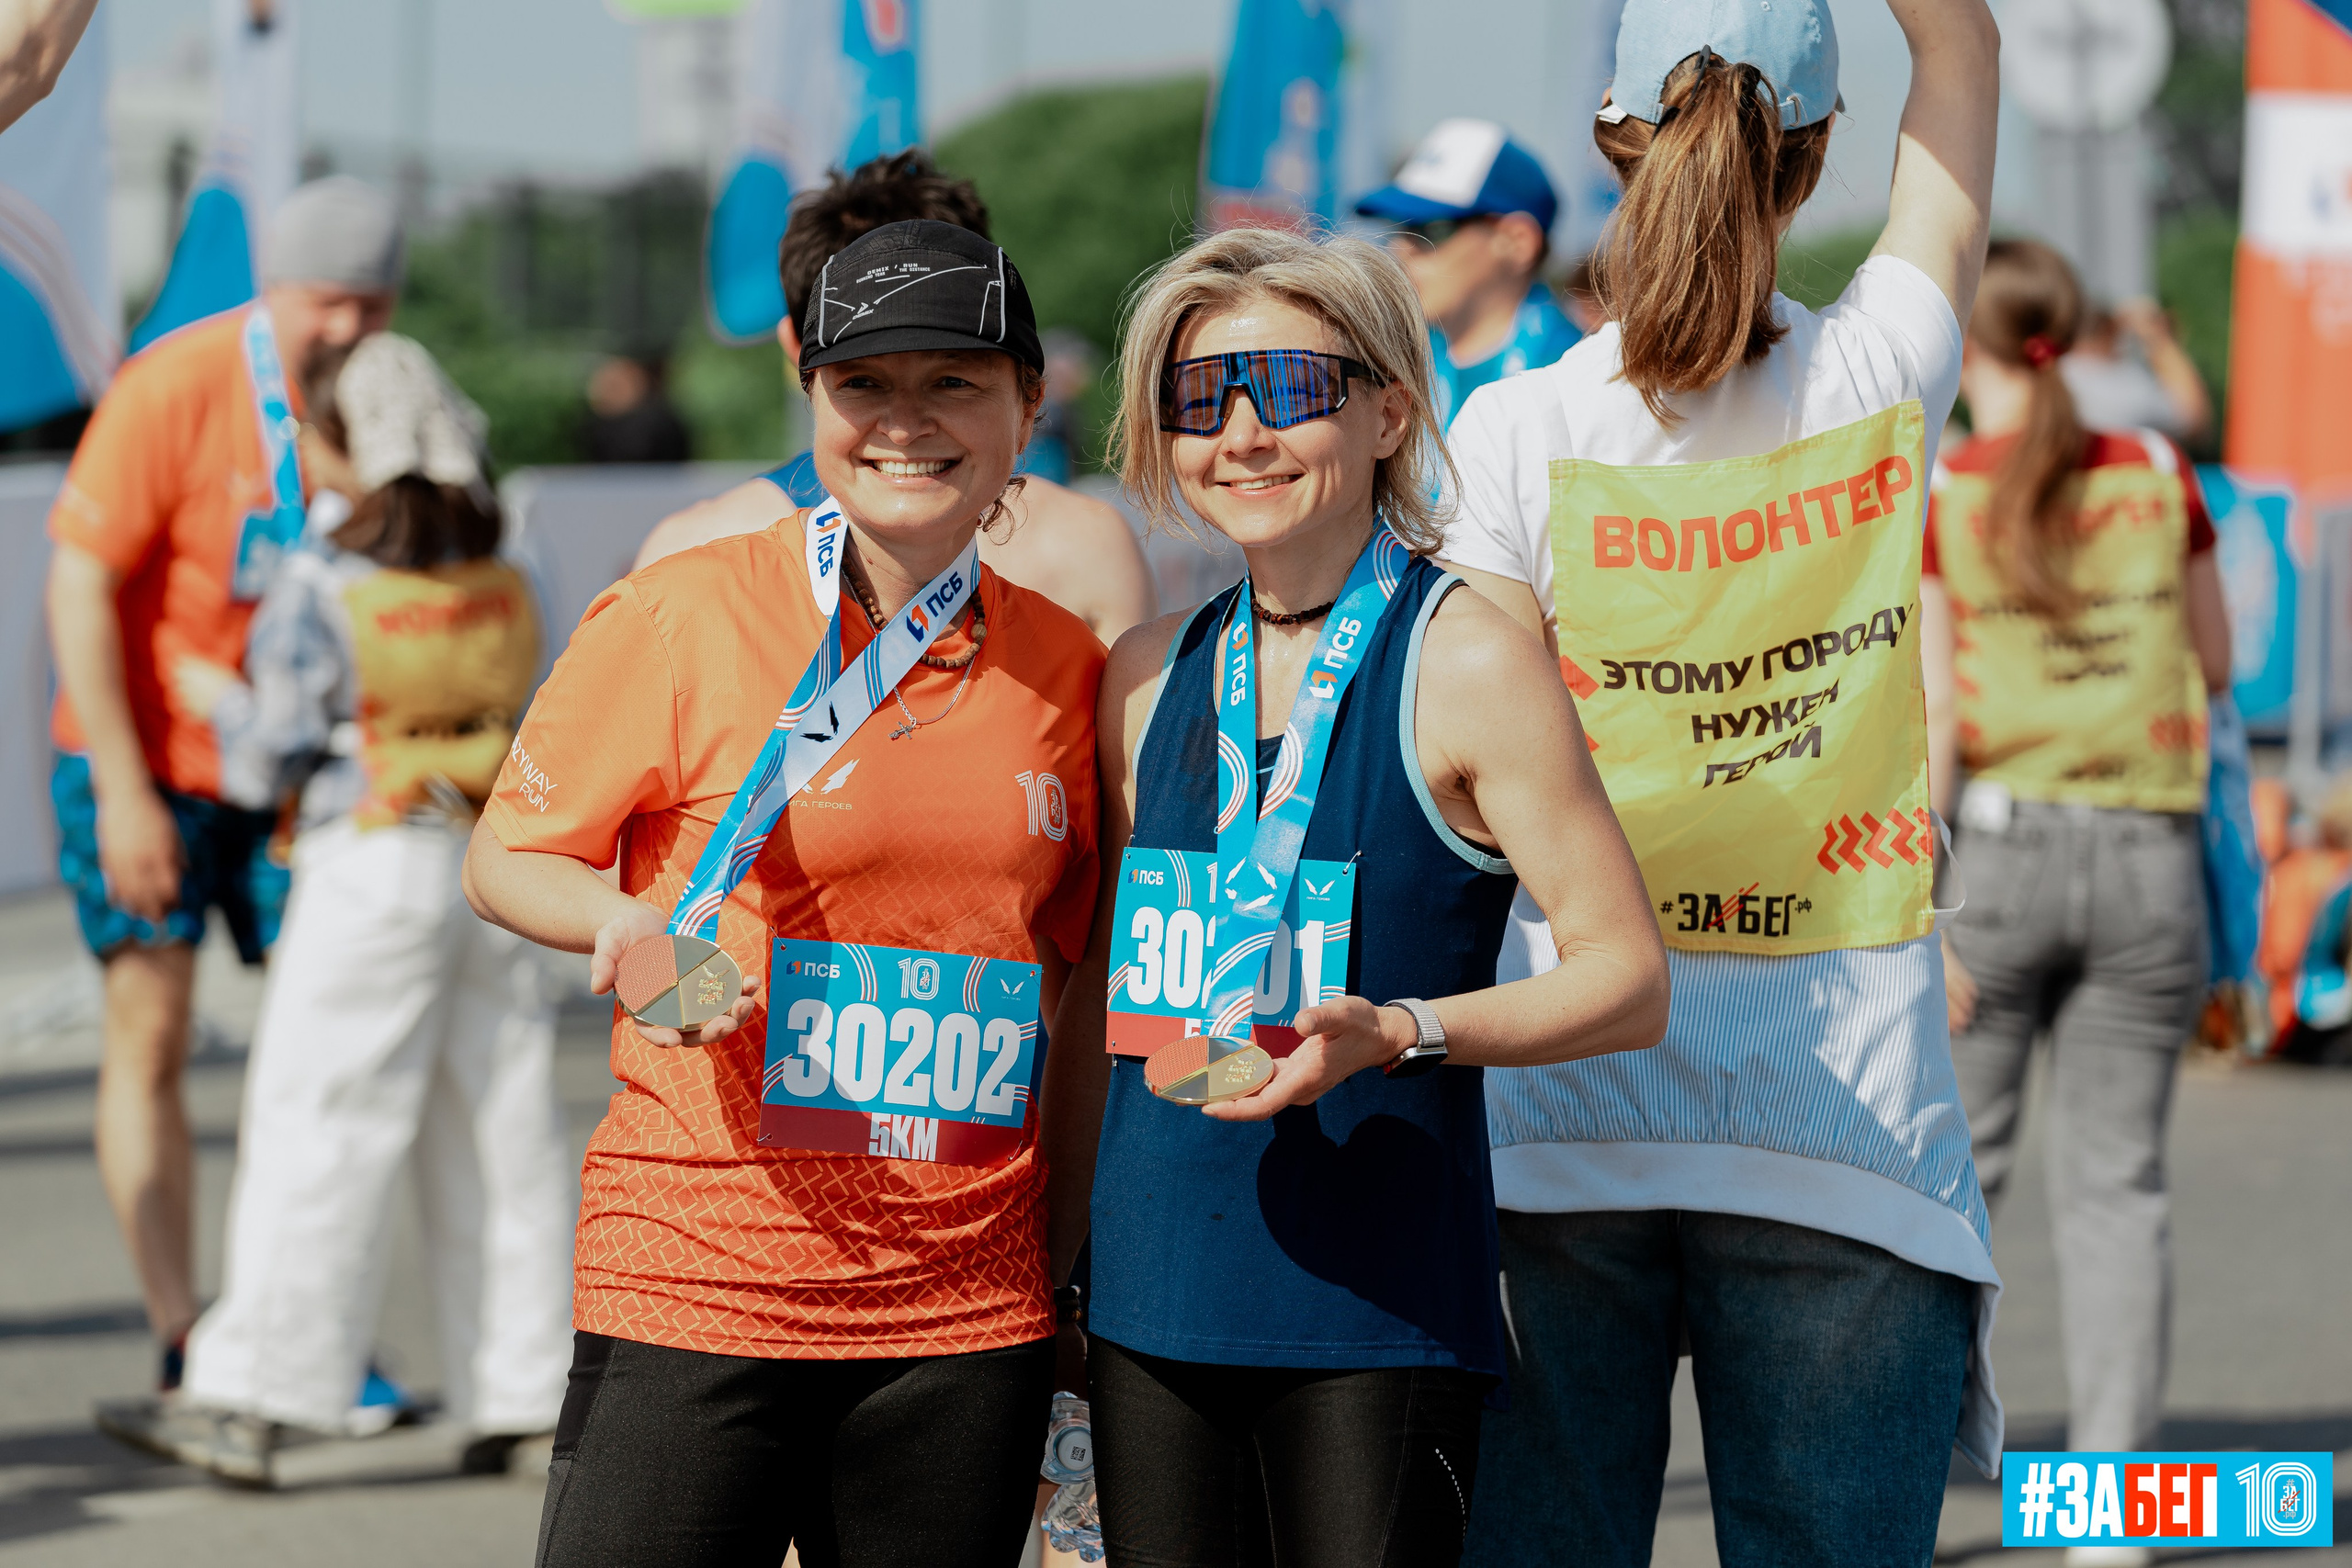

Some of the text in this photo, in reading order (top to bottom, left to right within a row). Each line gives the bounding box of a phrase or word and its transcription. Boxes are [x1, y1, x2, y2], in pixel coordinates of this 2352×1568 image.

[1593, 455, 1913, 572] ВОЛОНТЕР
[818, 533, 836, 578] ПСБ
[925, 570, 963, 617] ПСБ
[1323, 616, 1363, 670] ПСБ
[1600, 655, 1754, 694] ЭТОМУ
[1762, 603, 1914, 682] ГОРОДУ
[1230, 652, 1247, 706] ПСБ
[1691, 677, 1840, 743] НУЖЕН
[512, 735, 559, 795] ZYWAY
[1702, 720, 1822, 790] ГЕРОЙ
[518, 782, 549, 813] RUN
[788, 799, 853, 810] ИГА ГЕРОЕВ
[1014, 770, 1068, 842] 10
[1139, 870, 1164, 886] ПСБ
[1206, 862, 1218, 904] 1
[804, 962, 841, 979] ПСБ
[898, 957, 940, 1000] 10
[1126, 906, 1325, 1015] 3001
[782, 998, 1021, 1116] 30202
[868, 1111, 939, 1162] 5KM
